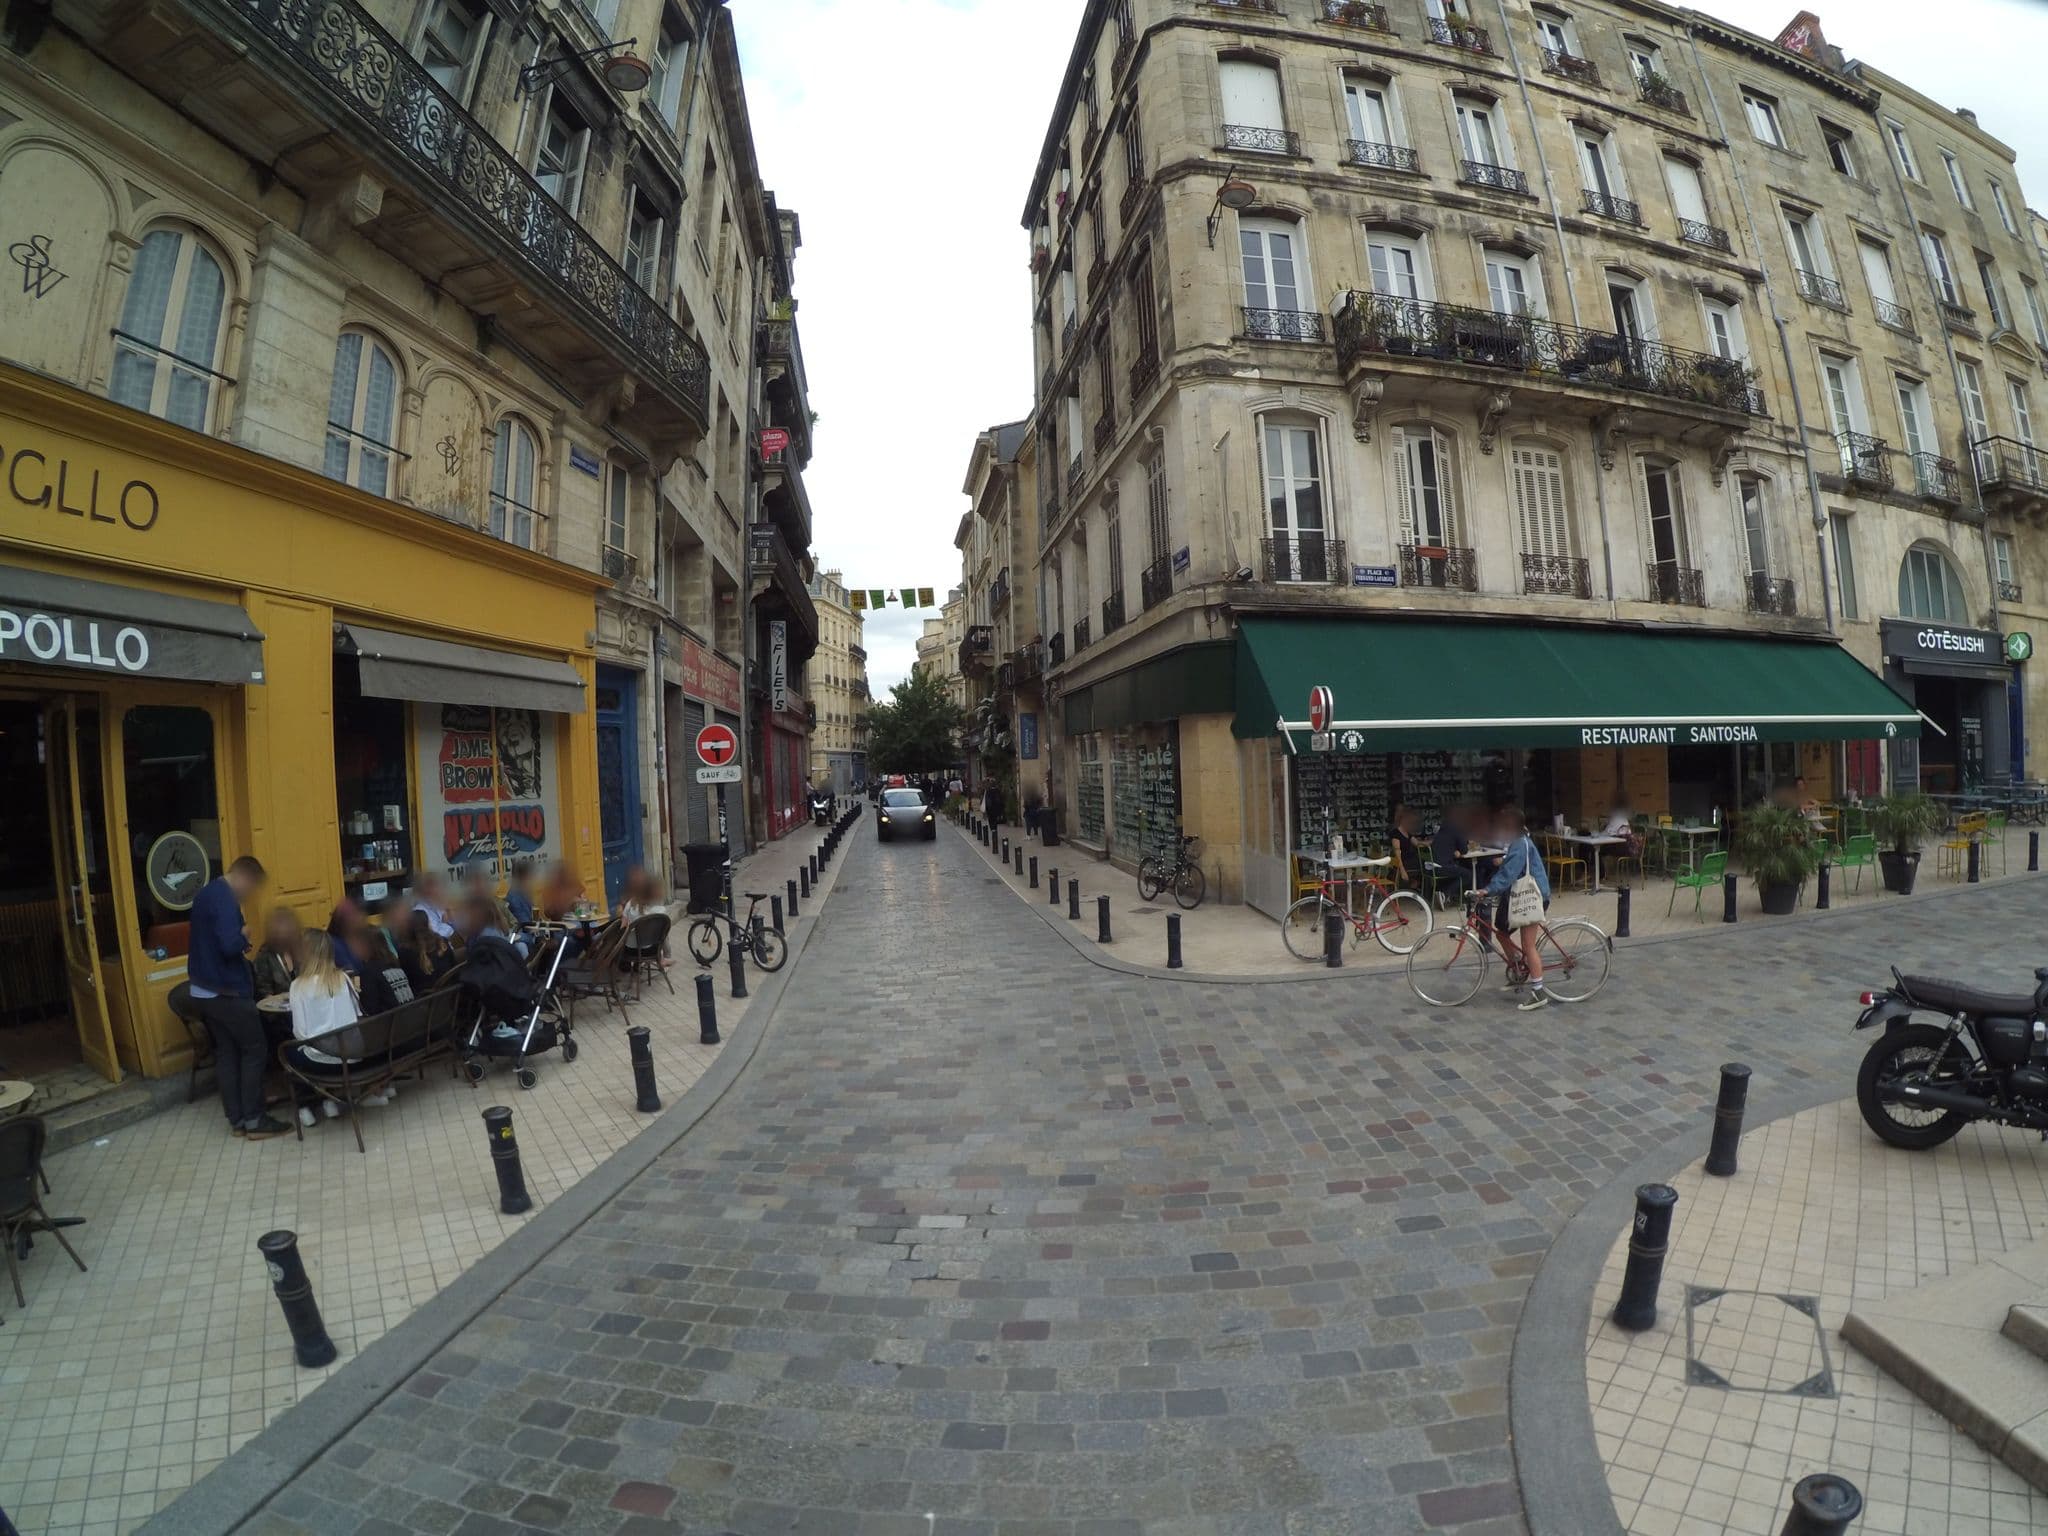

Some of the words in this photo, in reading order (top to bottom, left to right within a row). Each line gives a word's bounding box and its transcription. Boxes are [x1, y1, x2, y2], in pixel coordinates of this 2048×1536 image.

[773, 643, 784, 711] FILETS
[1581, 727, 1676, 744] RESTAURANT
[1690, 726, 1758, 742] SANTOSHA
[701, 771, 721, 779] SAUF
